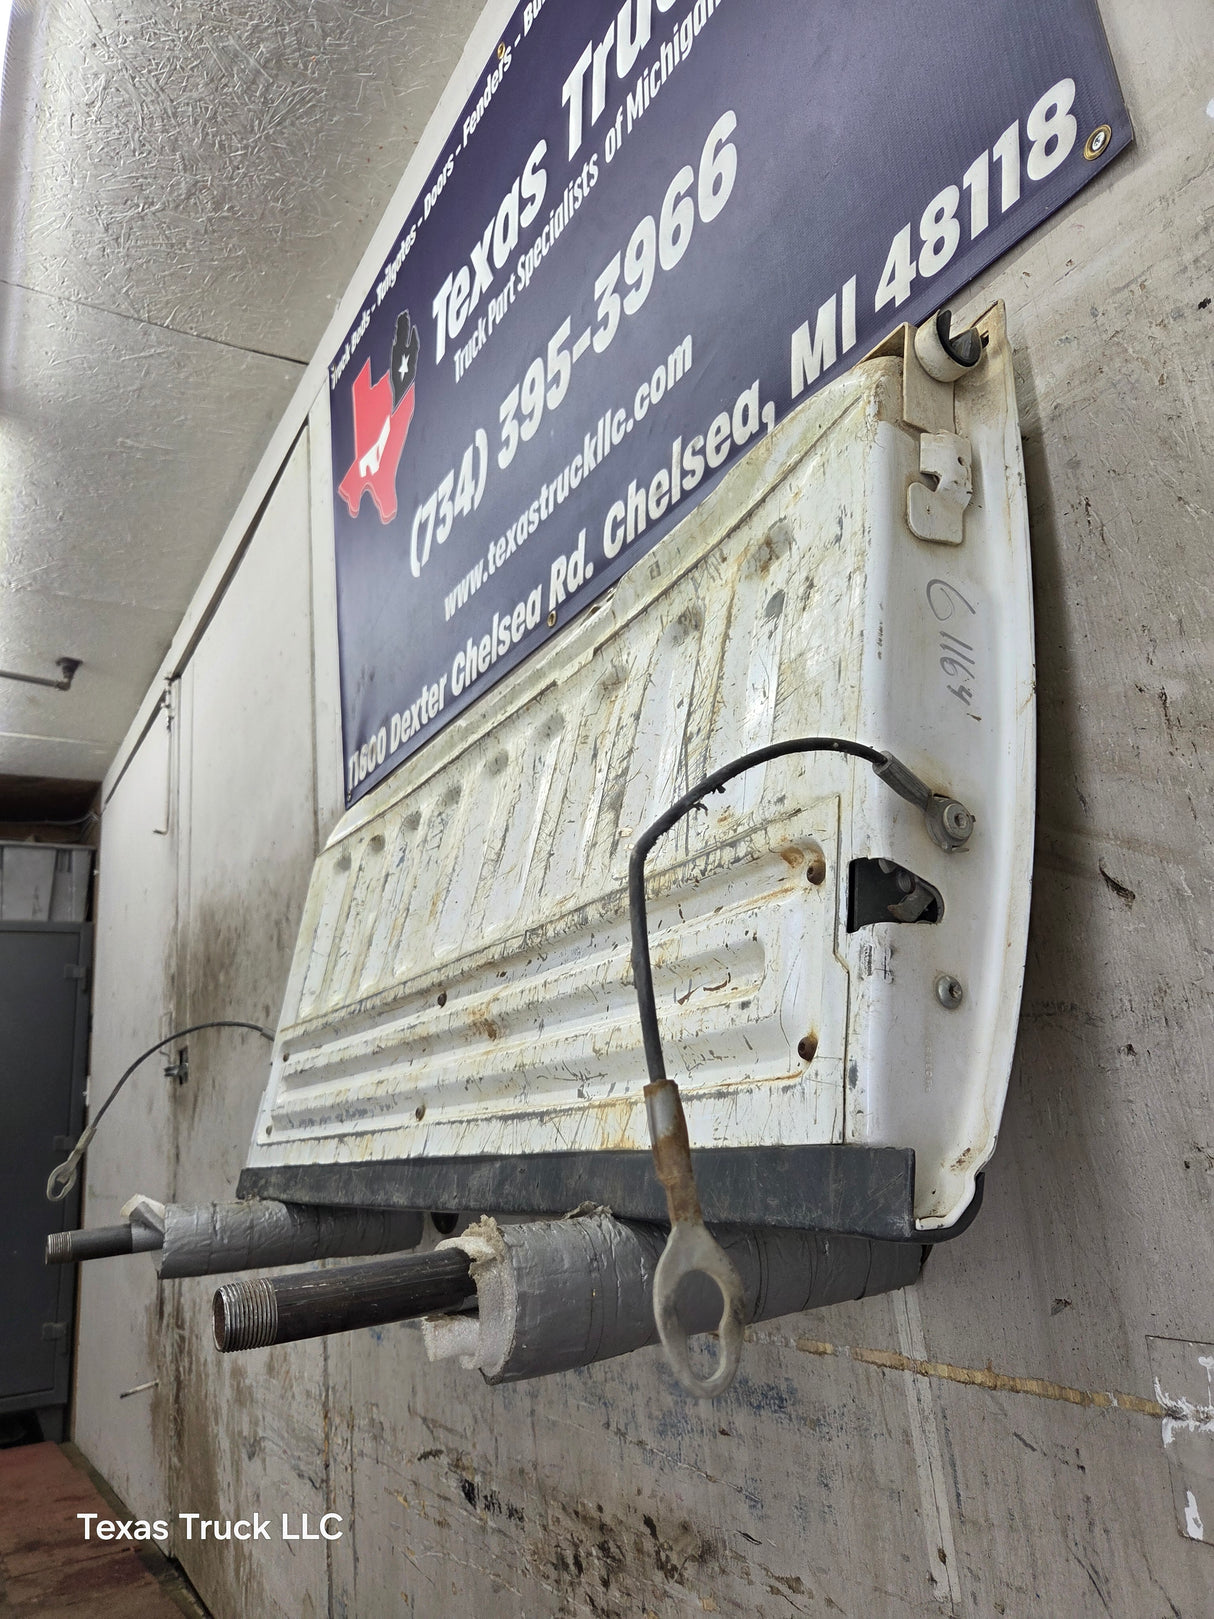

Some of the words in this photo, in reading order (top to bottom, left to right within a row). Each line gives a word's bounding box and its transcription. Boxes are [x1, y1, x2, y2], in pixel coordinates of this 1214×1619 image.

[351, 307, 371, 354] Beds
[376, 224, 416, 306] Tailgates
[424, 153, 454, 222] Doors
[463, 46, 512, 148] Fenders
[523, 0, 546, 37] Bu
[410, 428, 488, 578] (734)
[498, 110, 737, 469] 395-3966
[432, 139, 547, 365] Texas
[561, 0, 676, 162] Tru
[454, 316, 487, 384] Truck
[488, 273, 516, 336] Part
[517, 153, 598, 292] Specialists
[604, 105, 623, 164] of
[348, 726, 387, 792] 11600
[390, 673, 447, 754] Dexter
[451, 584, 542, 696] Chelsea
[548, 527, 594, 612] Rd.
[603, 378, 775, 559] Chelsea,
[791, 274, 857, 399] MI
[874, 77, 1077, 313] 48118
[444, 334, 692, 622] www.texastruckllc.com
